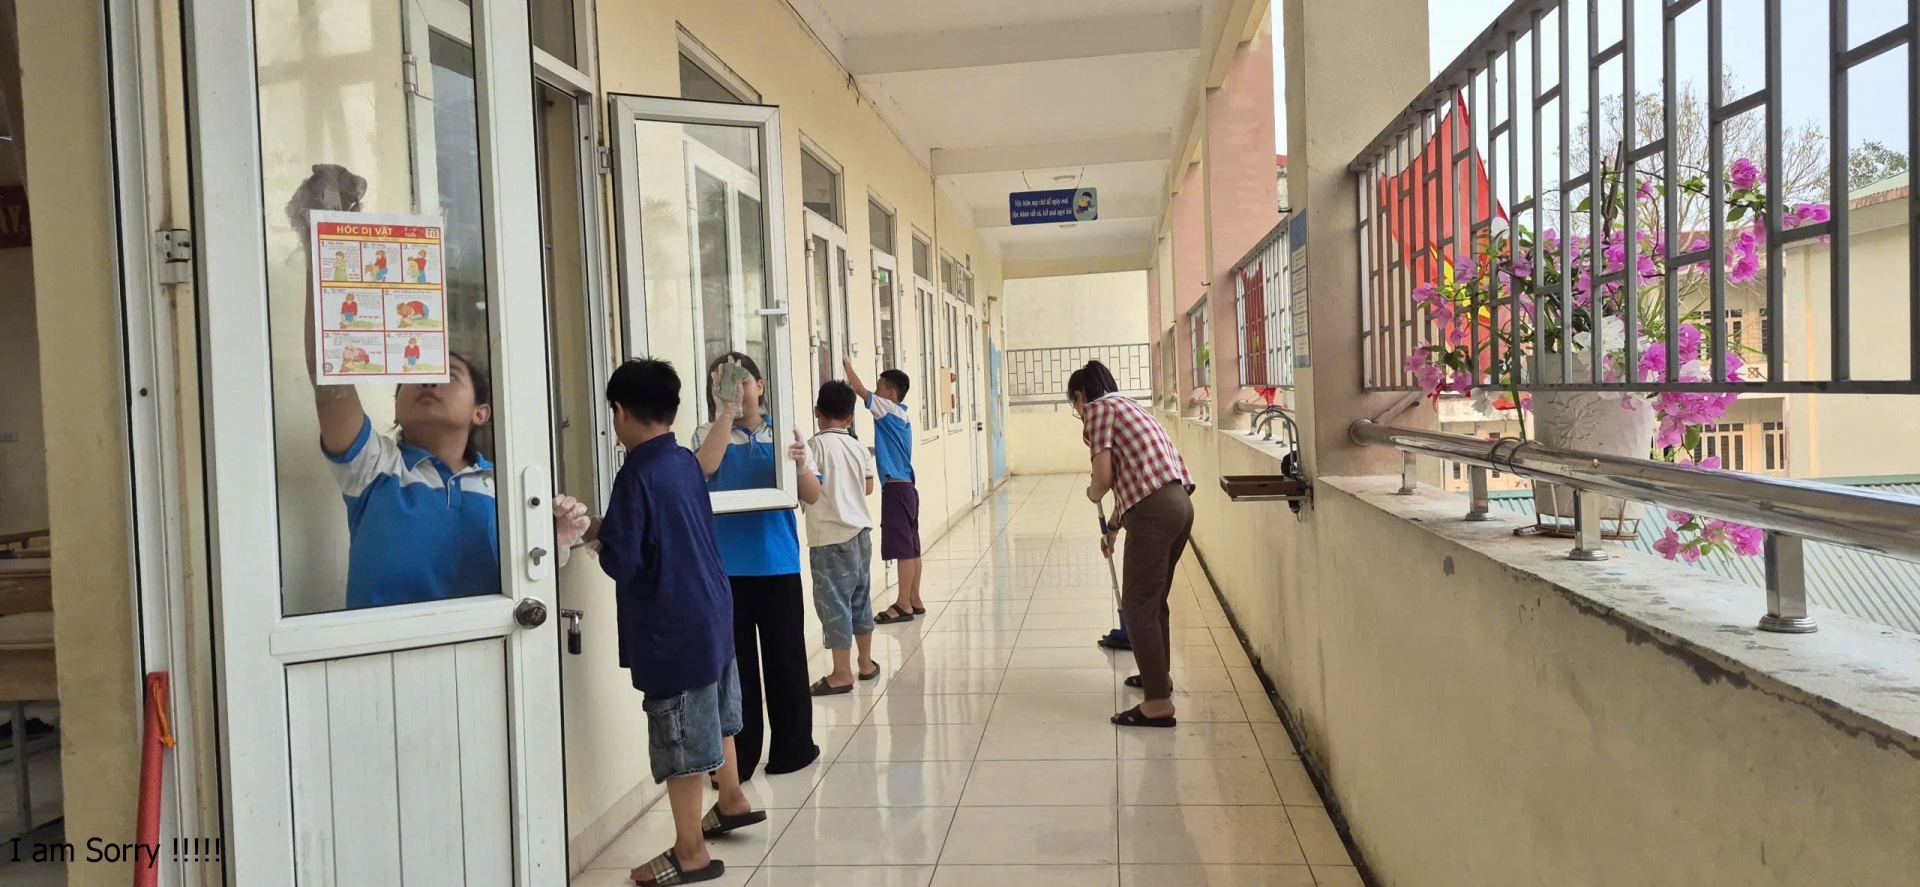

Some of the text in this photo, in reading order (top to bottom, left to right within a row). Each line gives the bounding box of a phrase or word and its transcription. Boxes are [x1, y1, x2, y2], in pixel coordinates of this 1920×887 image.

[336, 224, 359, 234] HÓC
[361, 226, 372, 237] DỊ
[374, 226, 393, 237] VẬT
